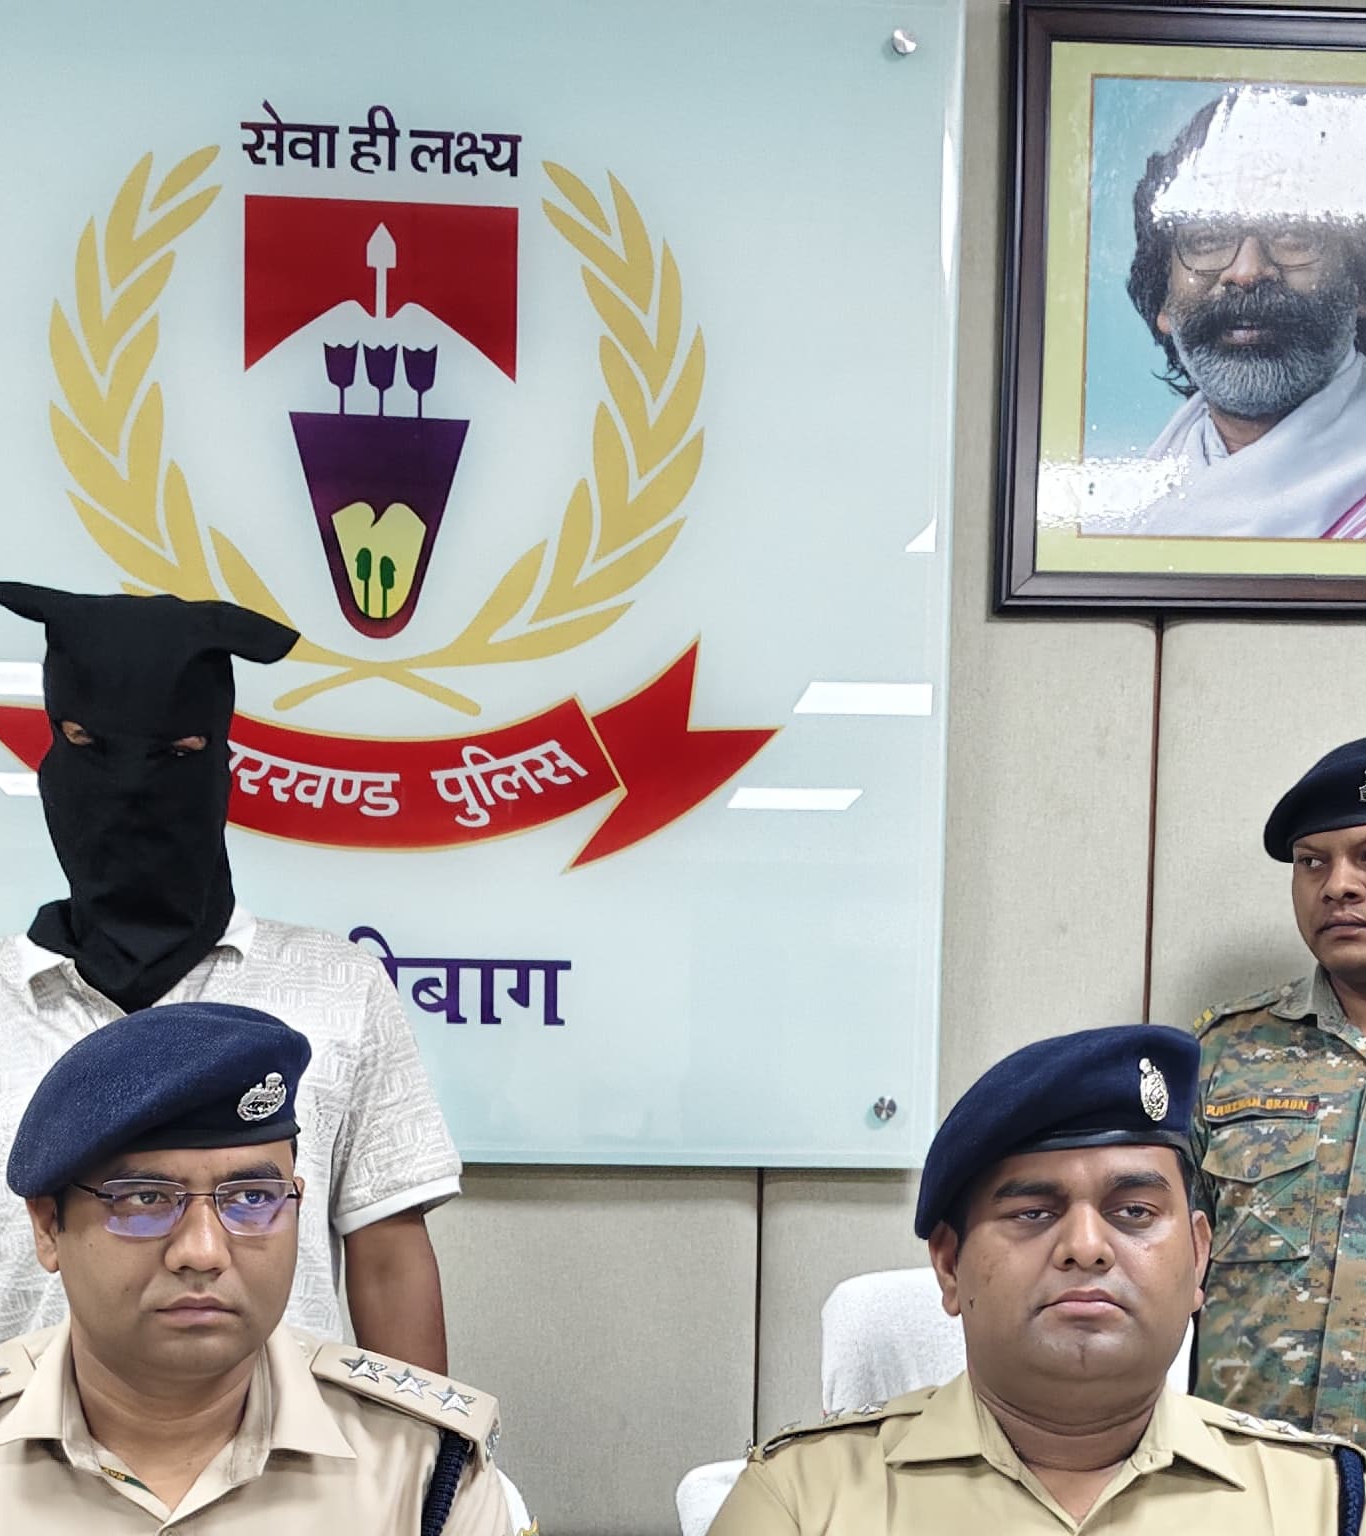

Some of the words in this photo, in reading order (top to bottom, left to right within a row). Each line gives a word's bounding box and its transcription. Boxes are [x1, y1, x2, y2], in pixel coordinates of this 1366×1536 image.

[240, 99, 339, 169] सेवा
[349, 105, 401, 174] ही
[409, 129, 522, 177] लक्ष्य
[227, 739, 400, 817] ारखण्ड
[430, 739, 589, 828] पुलिस
